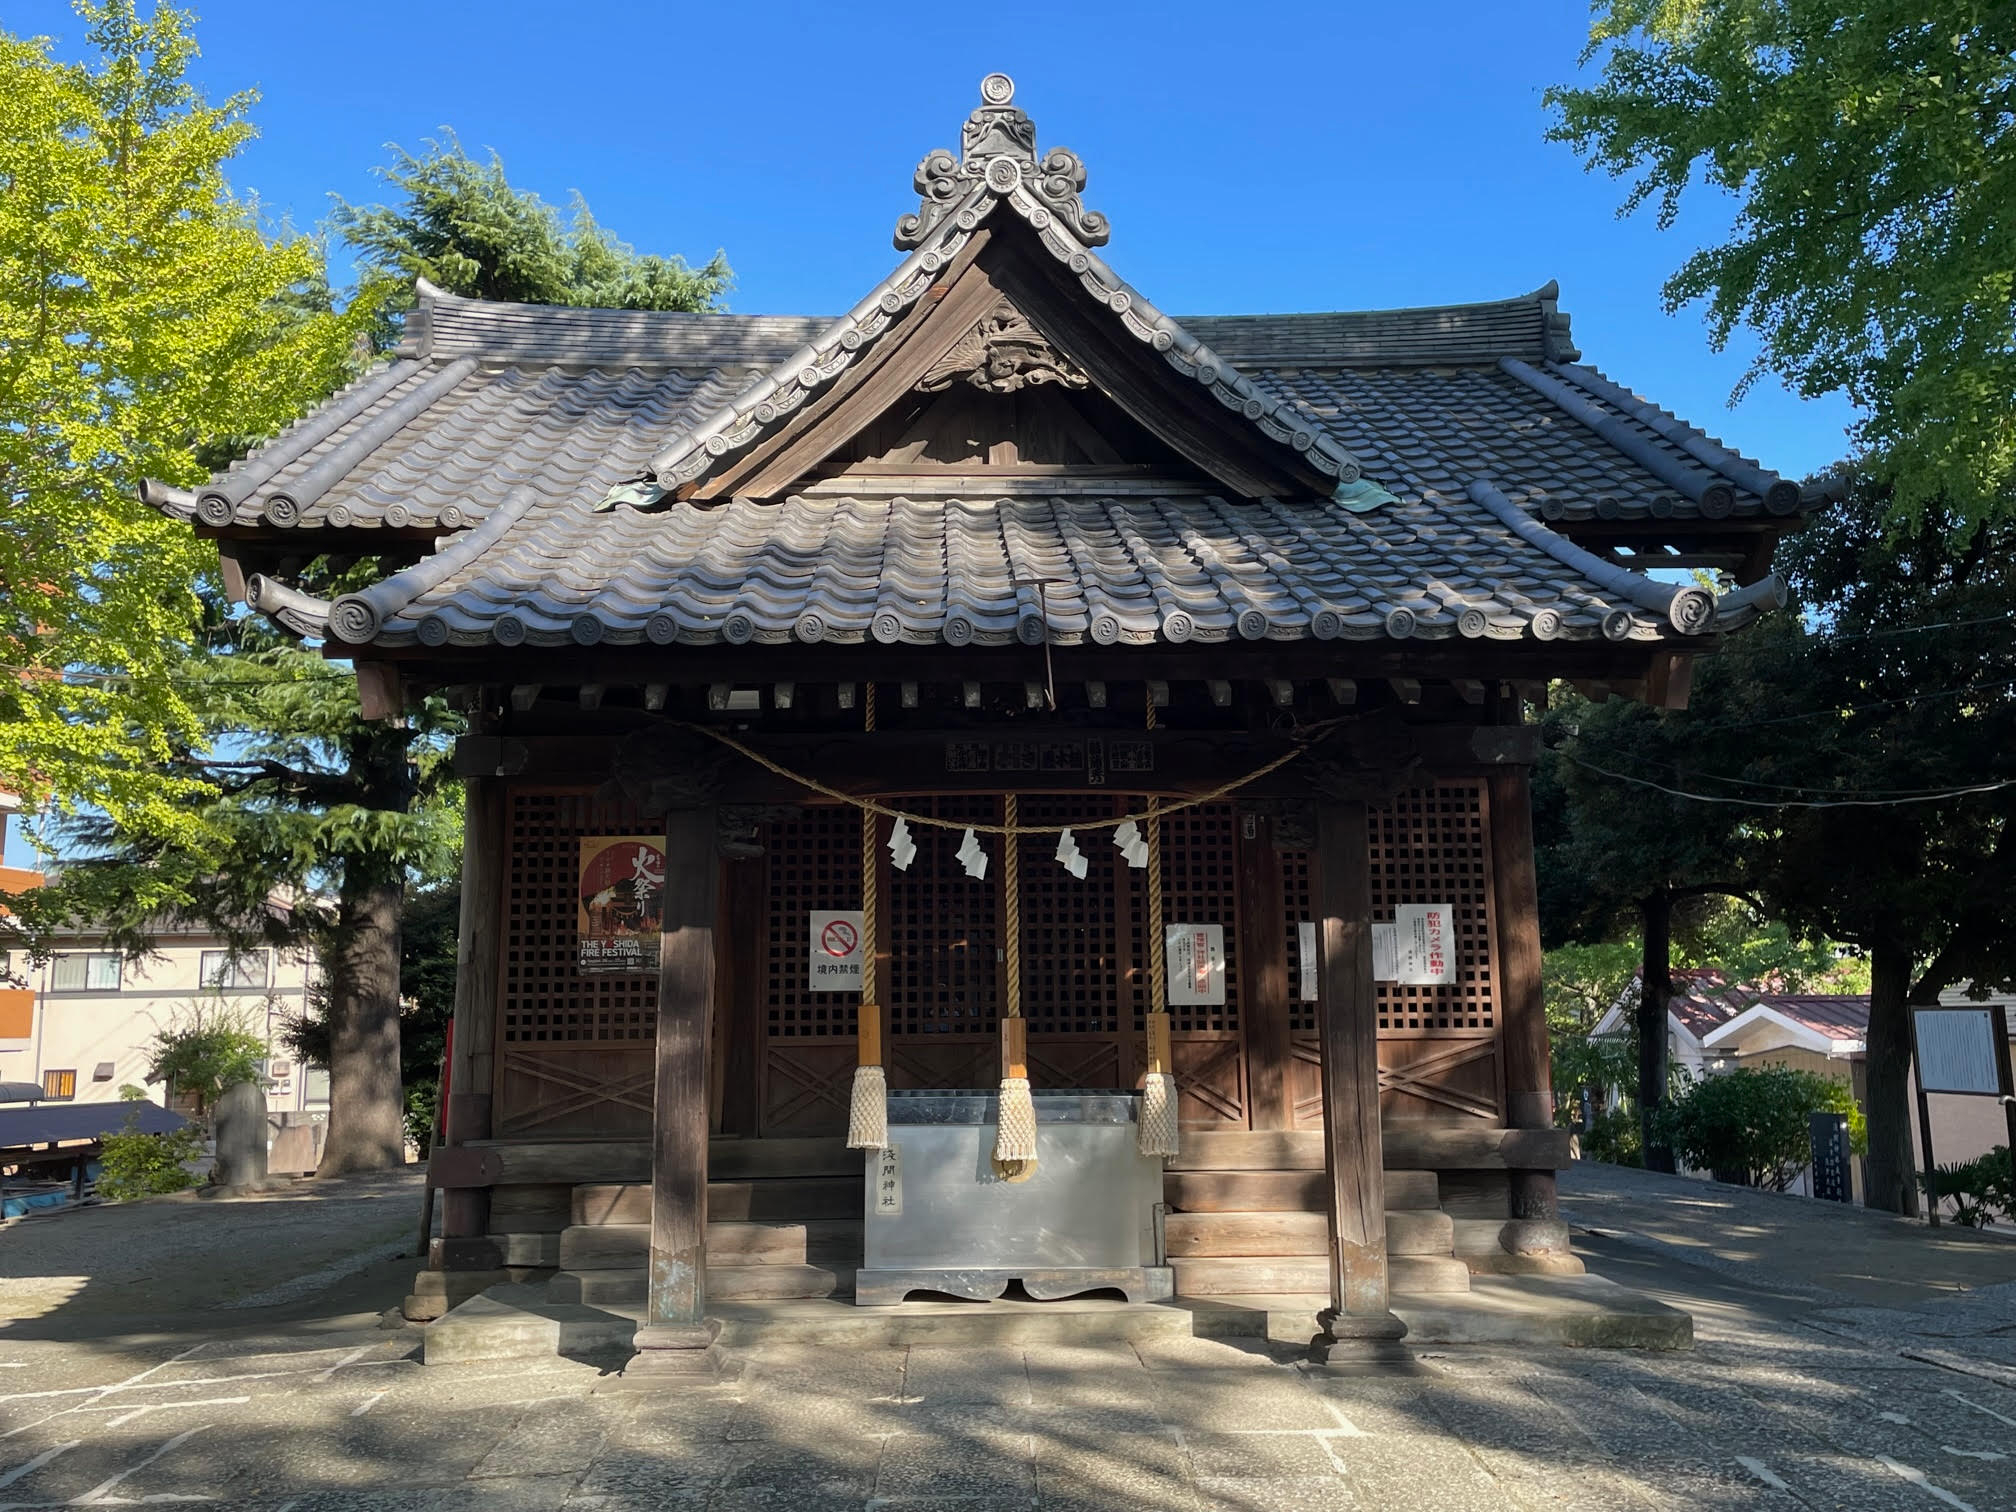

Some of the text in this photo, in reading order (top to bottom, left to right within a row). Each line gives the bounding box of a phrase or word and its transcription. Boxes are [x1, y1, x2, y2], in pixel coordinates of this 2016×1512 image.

[630, 846, 665, 917] 火祭り
[581, 940, 598, 949] THE
[1426, 911, 1444, 976] 防犯カメラ作動中
[581, 948, 642, 957] FIRE FESTIVAL
[817, 964, 860, 975] 境内禁煙
